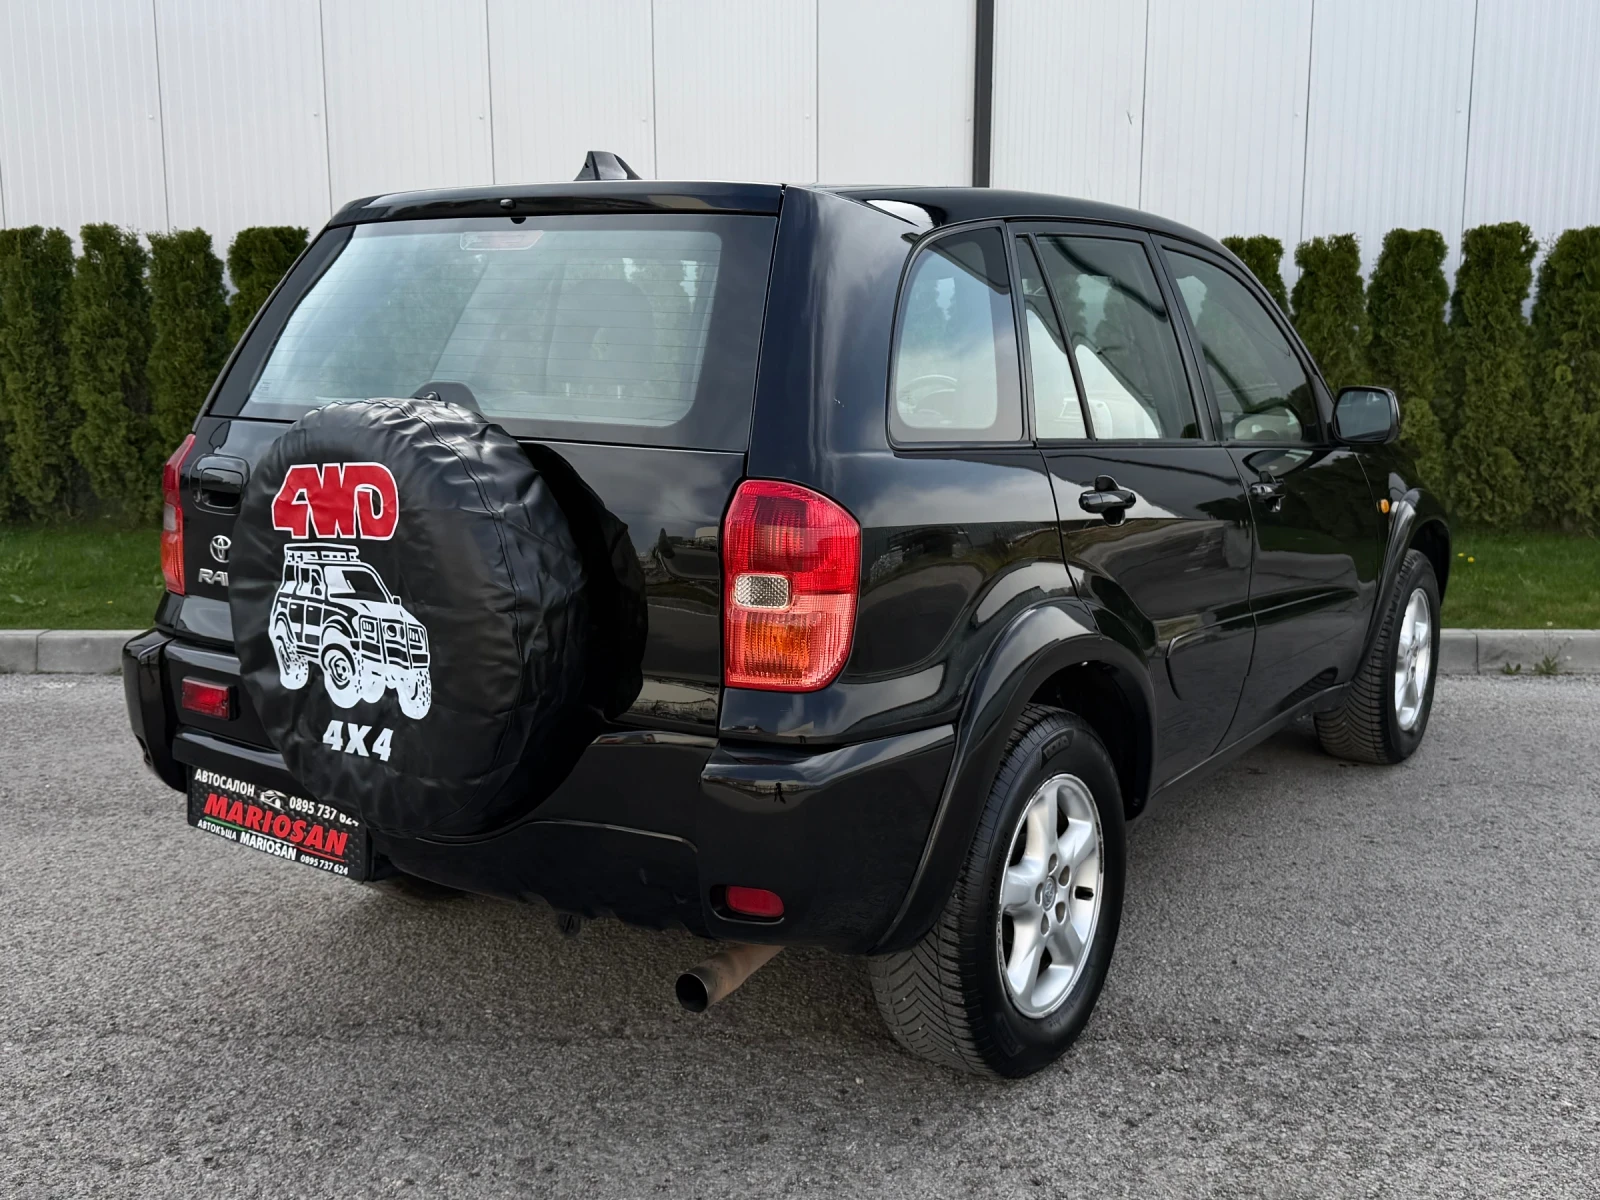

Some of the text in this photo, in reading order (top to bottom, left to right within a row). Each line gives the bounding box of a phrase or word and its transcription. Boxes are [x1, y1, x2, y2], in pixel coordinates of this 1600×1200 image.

[271, 462, 399, 541] 4WD
[322, 720, 393, 762] 4X4
[194, 768, 255, 797] АВТОСАЛОН
[289, 796, 315, 815] 0895
[317, 804, 337, 820] 737
[197, 819, 349, 876] АВТОКЪЩА MARIOSAN 0895 737 624
[204, 793, 348, 856] MARIOSAN
